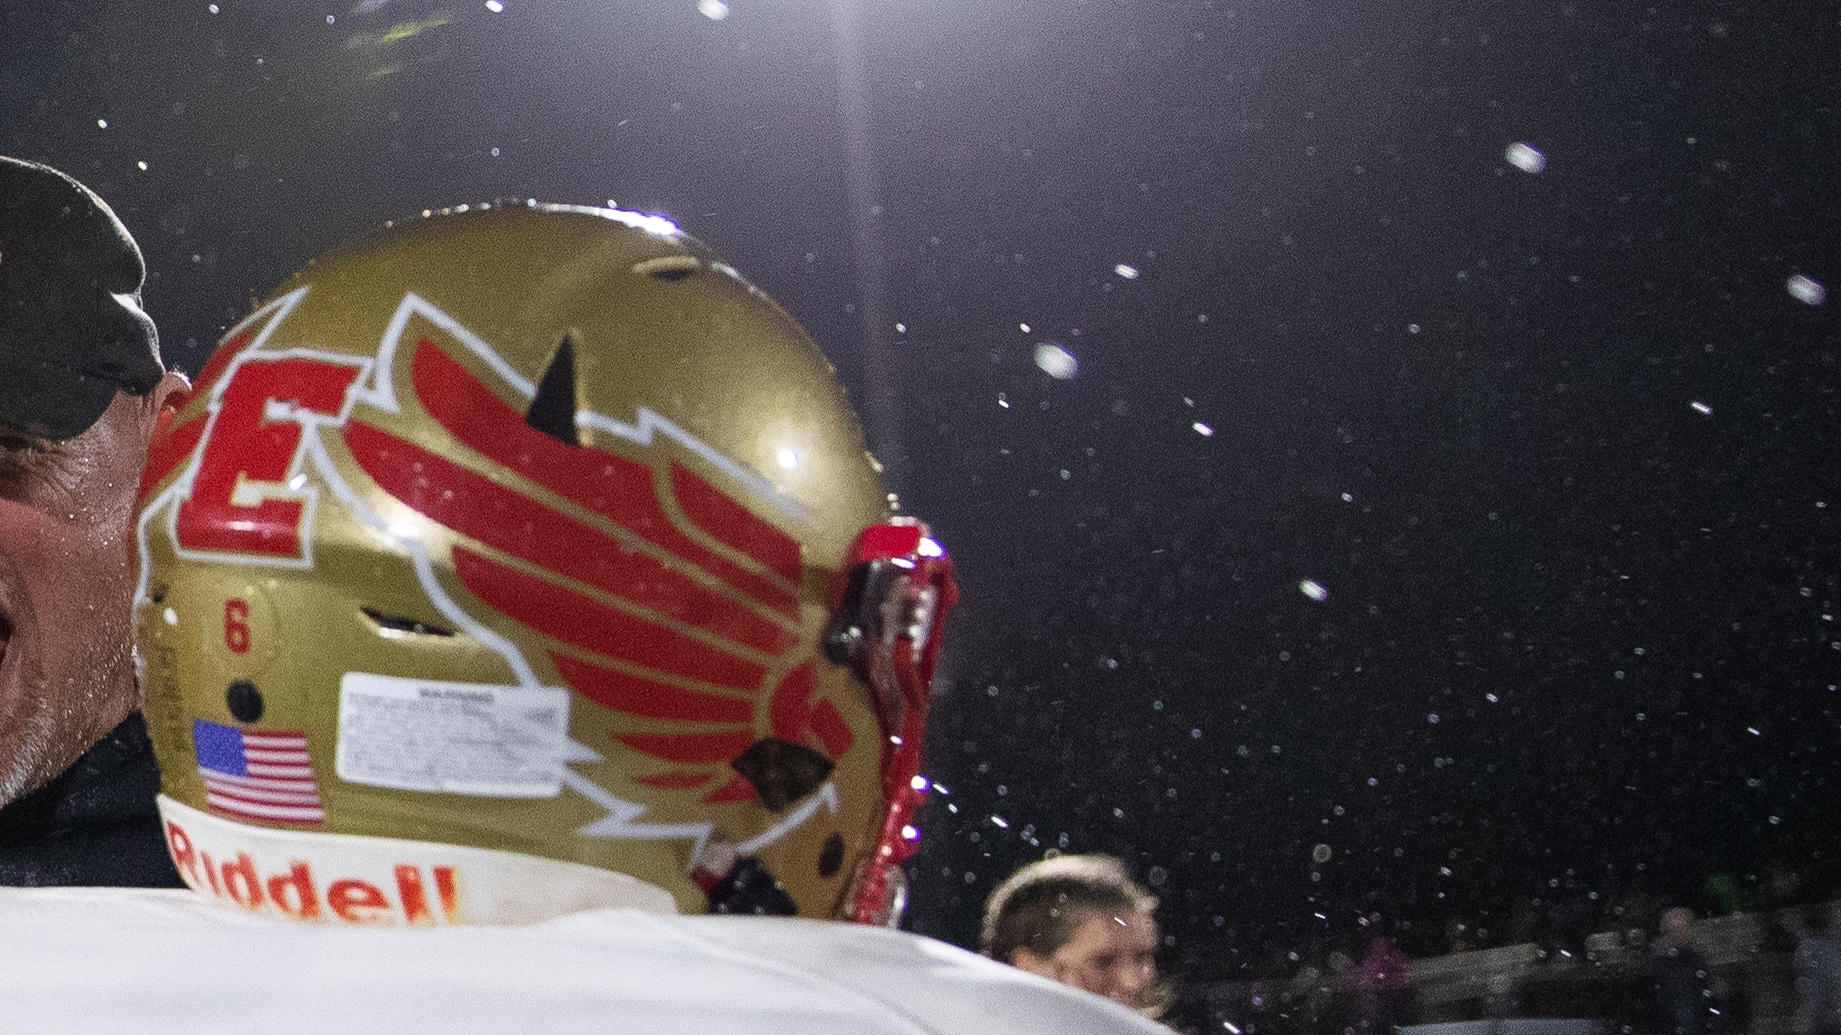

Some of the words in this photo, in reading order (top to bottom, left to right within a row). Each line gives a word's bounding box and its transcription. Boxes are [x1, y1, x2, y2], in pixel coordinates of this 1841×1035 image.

[167, 348, 375, 568] E
[223, 597, 251, 655] 6
[167, 820, 460, 926] Riddell
